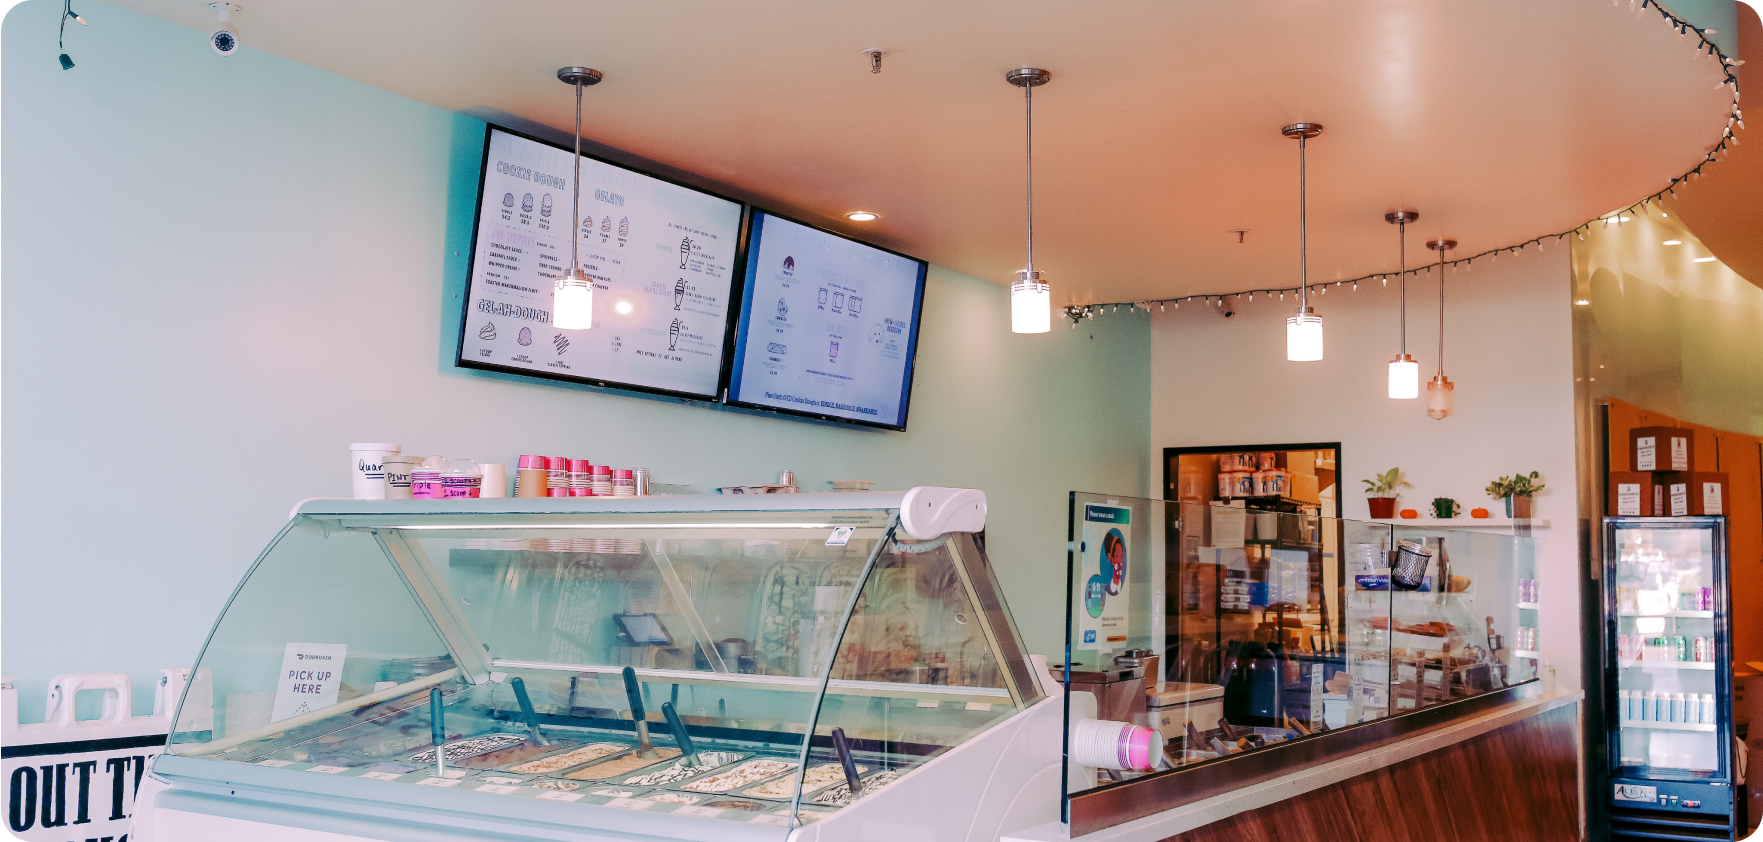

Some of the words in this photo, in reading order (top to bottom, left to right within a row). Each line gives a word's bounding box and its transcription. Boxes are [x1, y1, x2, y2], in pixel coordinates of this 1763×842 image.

[497, 161, 532, 181] COOKIE
[534, 171, 566, 190] DOUGH
[594, 188, 625, 207] GELATO
[477, 298, 549, 323] GEL-AH-DOUGH
[358, 459, 384, 472] Quar
[387, 472, 410, 483] PINT
[1092, 581, 1097, 592] 6
[288, 670, 314, 680] PICK
[317, 671, 332, 681] UP
[293, 683, 322, 694] HERE
[9, 760, 97, 832] OUT
